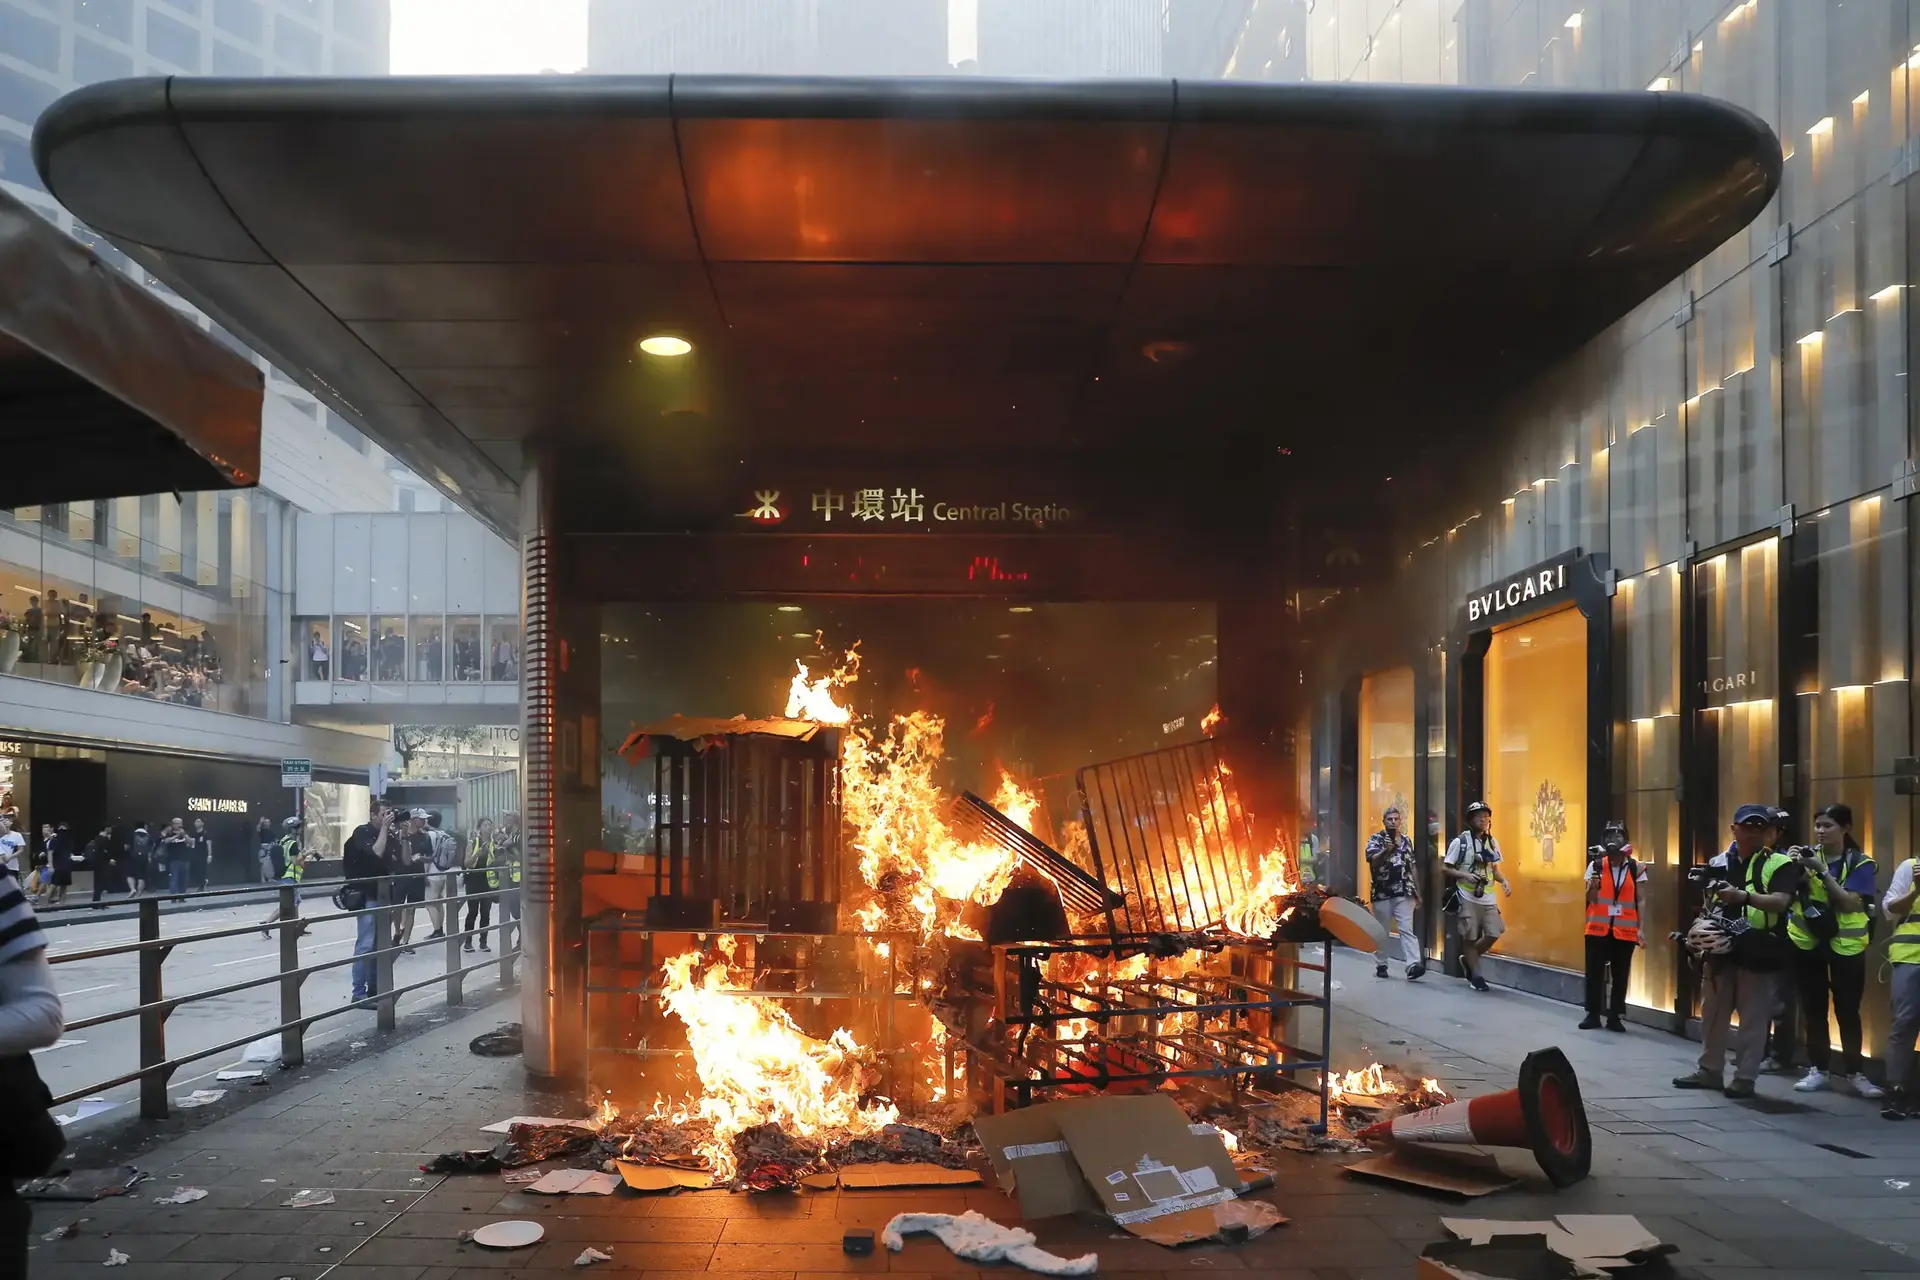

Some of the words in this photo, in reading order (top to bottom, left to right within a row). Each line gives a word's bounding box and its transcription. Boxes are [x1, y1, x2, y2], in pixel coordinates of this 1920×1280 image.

[811, 488, 926, 522] 中環站
[932, 502, 1007, 522] Central
[1468, 564, 1564, 622] BVLGARI
